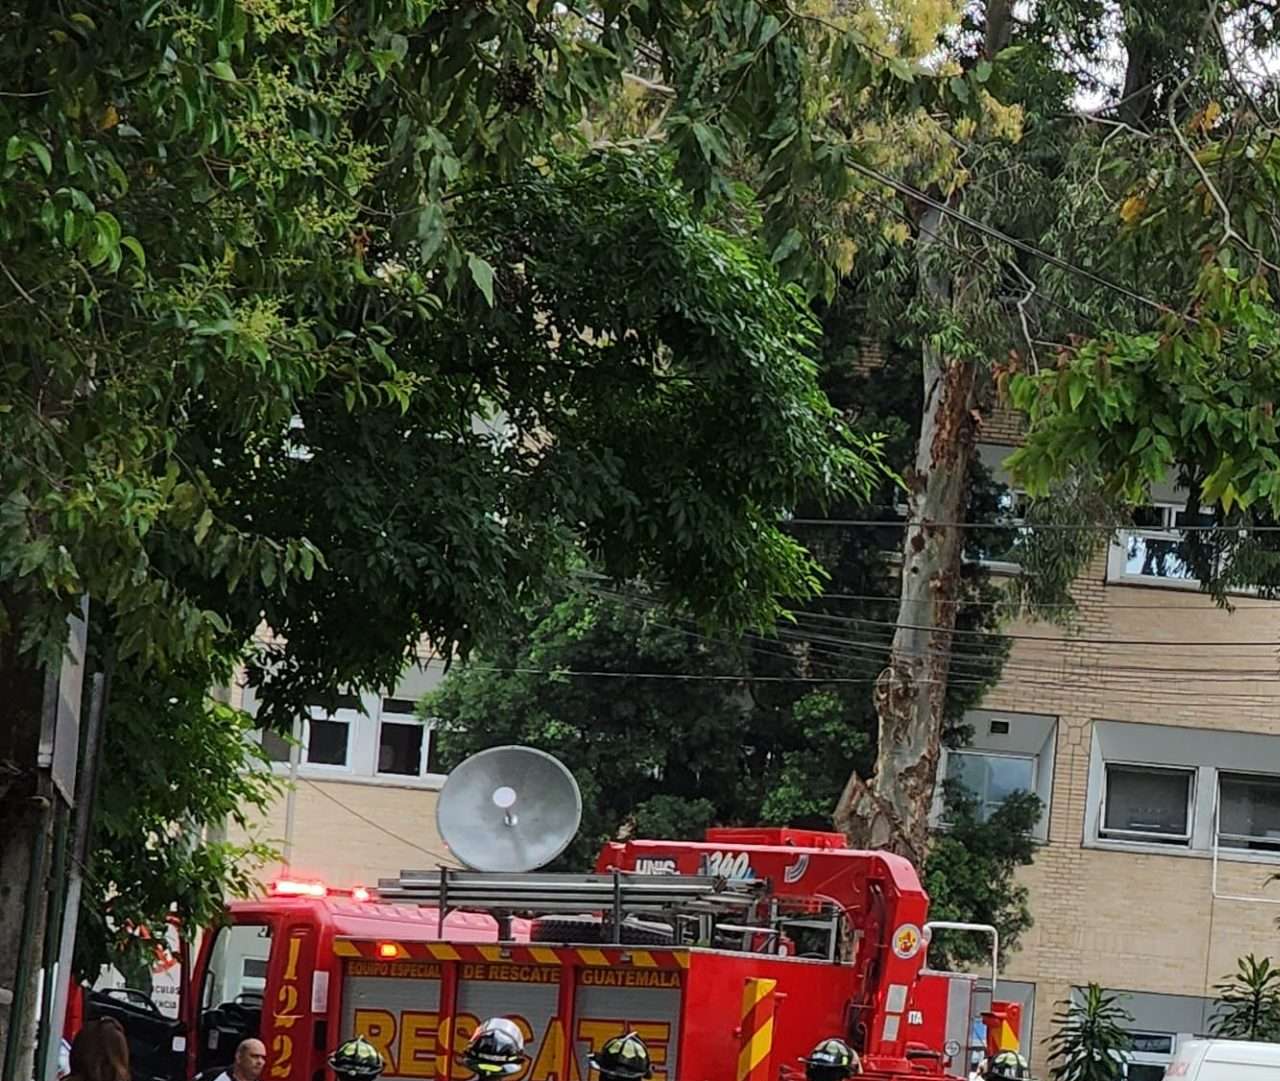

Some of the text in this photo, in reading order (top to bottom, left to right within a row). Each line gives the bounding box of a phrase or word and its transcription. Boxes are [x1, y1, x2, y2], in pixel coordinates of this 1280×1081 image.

[349, 963, 680, 988] EQUIPO ESPECIAL DE RESCATE GUATEMALA
